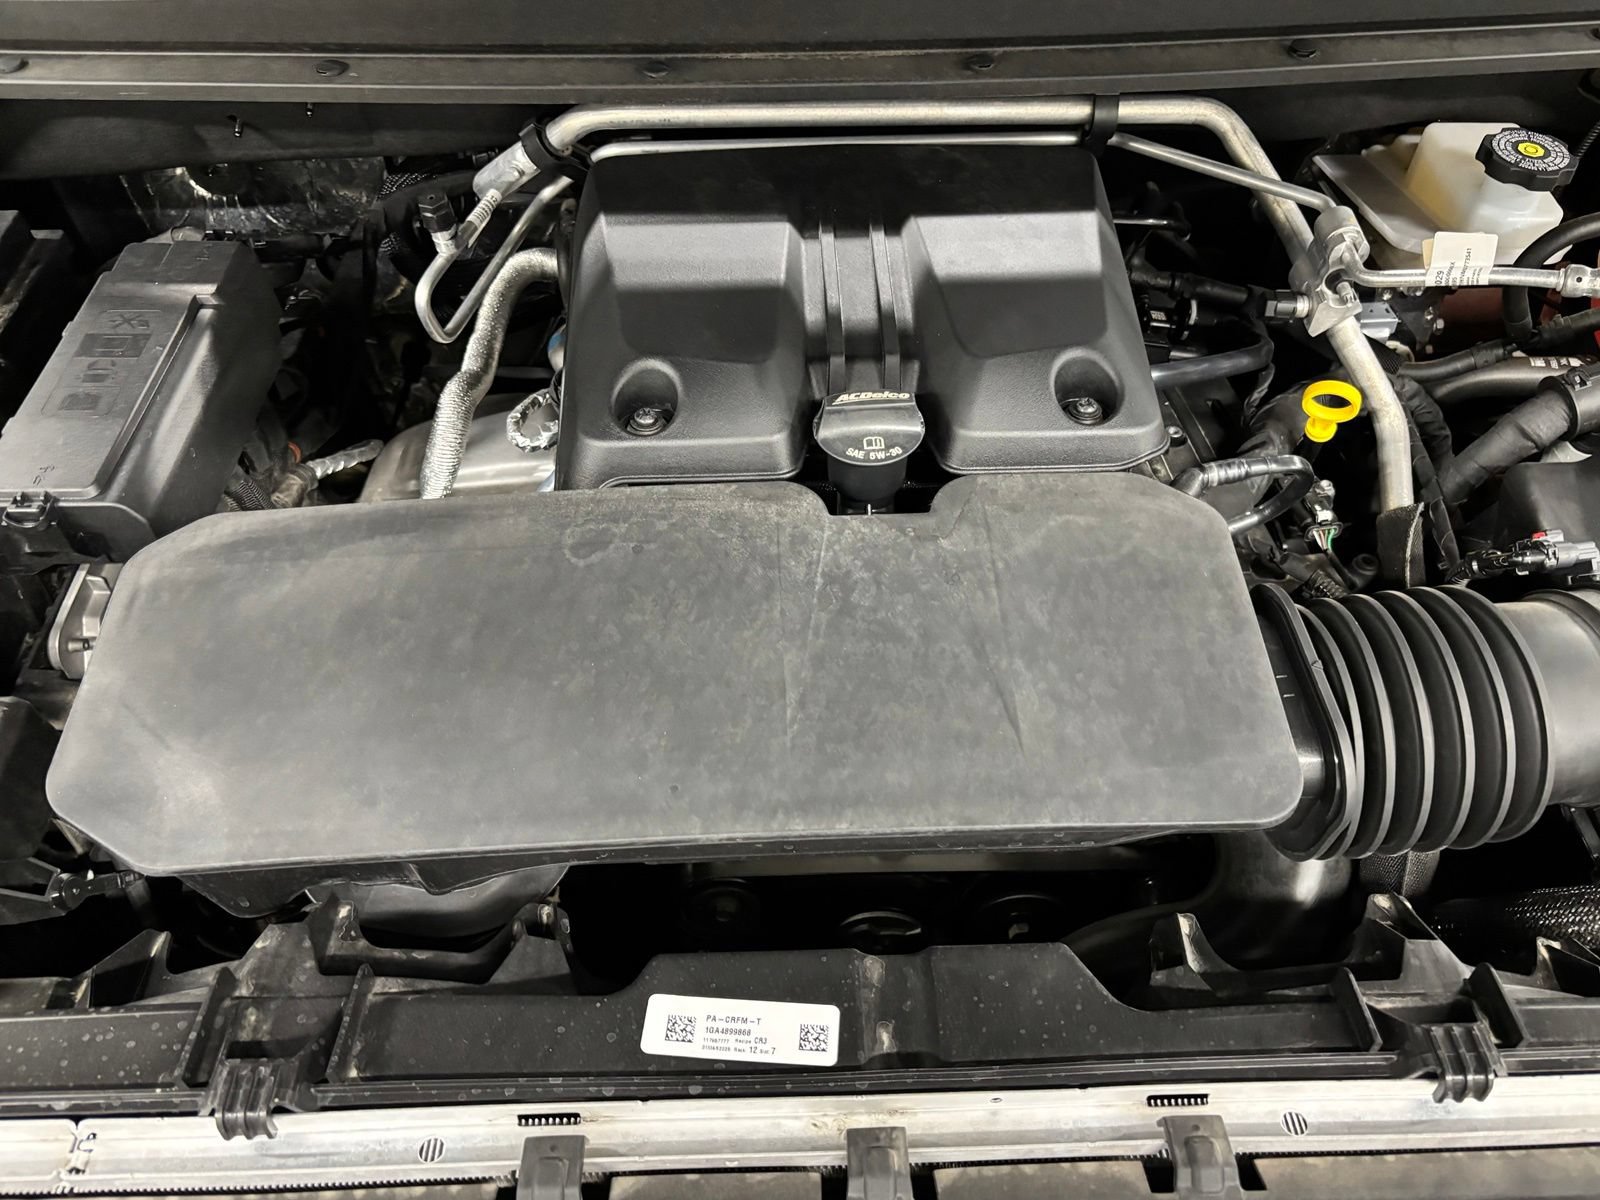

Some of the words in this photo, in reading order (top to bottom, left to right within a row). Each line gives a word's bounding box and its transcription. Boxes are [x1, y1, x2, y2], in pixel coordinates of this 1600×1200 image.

[831, 391, 910, 406] ACDelco
[845, 447, 865, 459] SAE
[869, 446, 903, 460] 5W-30
[754, 1036, 768, 1045] CR3
[749, 1046, 758, 1054] 12
[771, 1047, 776, 1055] 7
